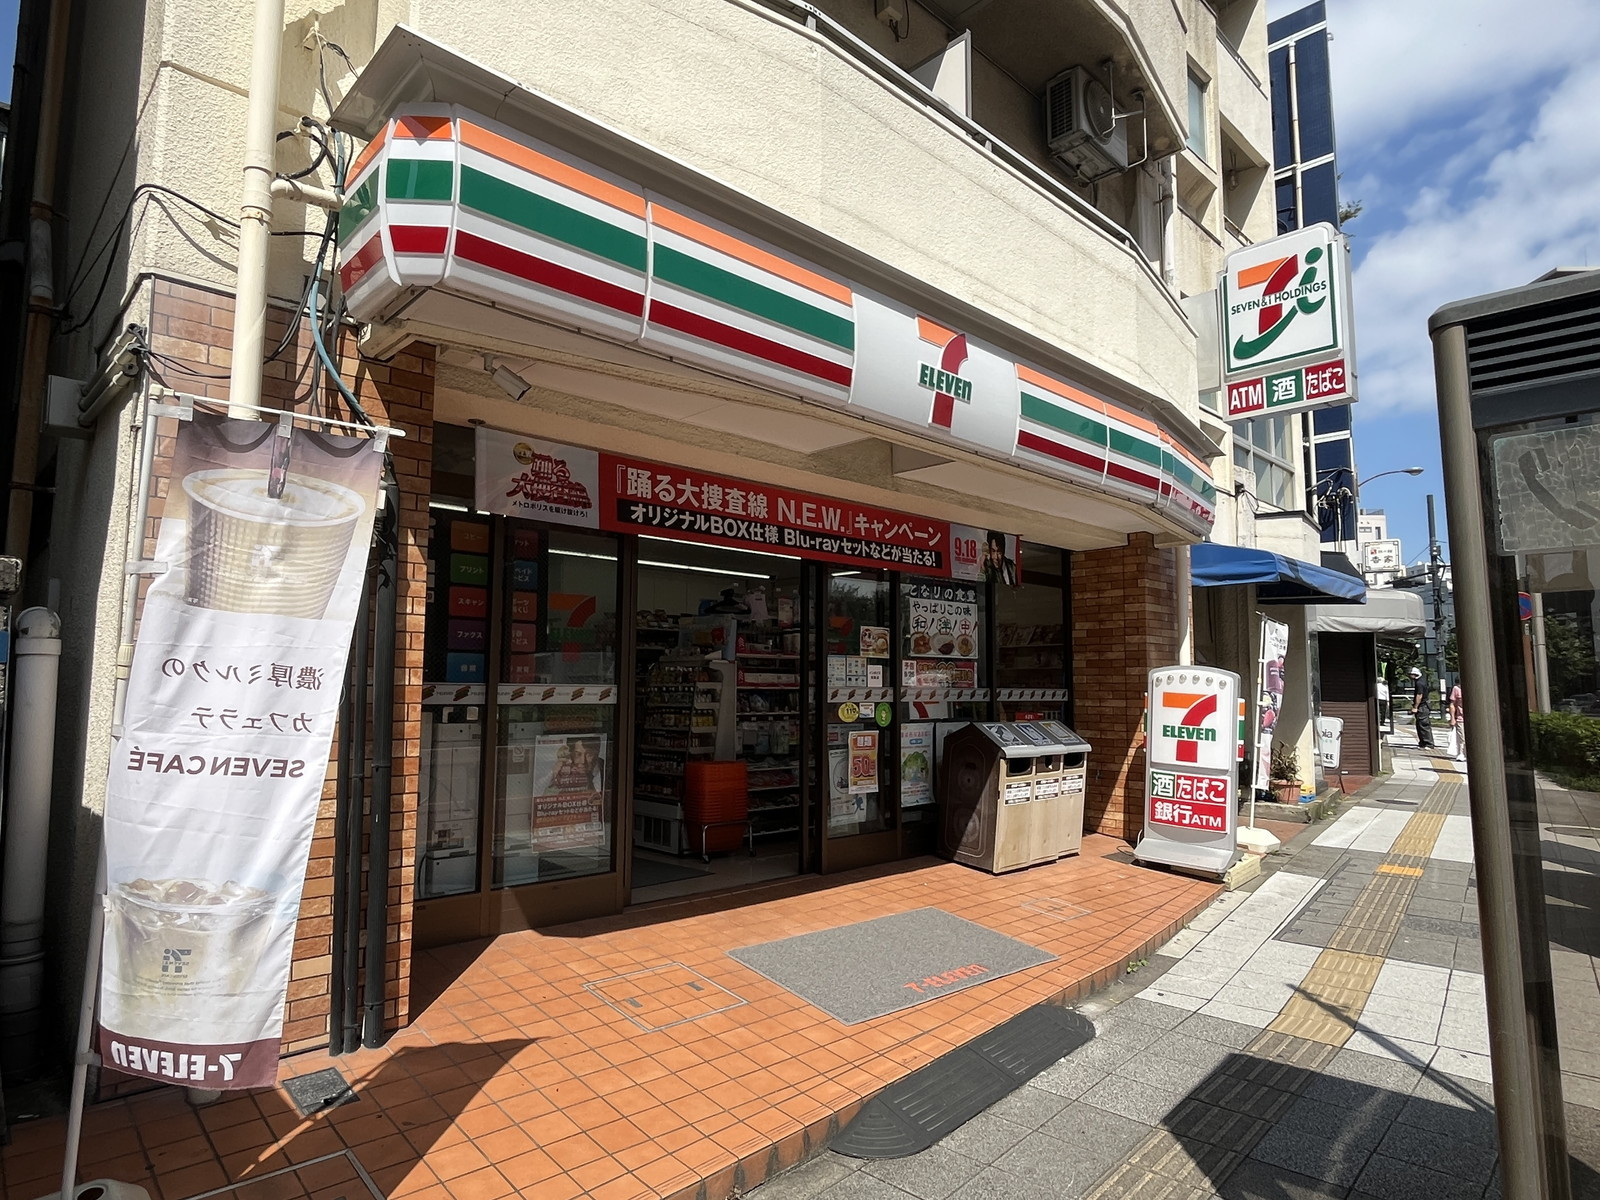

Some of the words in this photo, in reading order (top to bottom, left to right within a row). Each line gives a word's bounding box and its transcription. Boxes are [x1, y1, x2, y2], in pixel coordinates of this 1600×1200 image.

[1274, 280, 1327, 303] HOLDINGS
[920, 363, 972, 402] ELEVEN
[1272, 375, 1296, 402] 酒
[1306, 367, 1344, 395] たばこ
[1230, 383, 1262, 411] ATM
[616, 464, 768, 519] 『踊る大捜査線
[630, 503, 779, 543] オリジナルBOX仕様
[784, 528, 936, 567] Blu-rayセットなどが当たる!
[955, 537, 977, 559] 9.18
[459, 565, 485, 574] プリント
[457, 597, 484, 606] スキャン
[909, 583, 977, 603] となりの食堂
[912, 601, 972, 616] やっぱりこの味
[456, 630, 483, 639] ファクス
[1162, 725, 1217, 742] ELEVEN
[1152, 771, 1174, 797] 酒
[1176, 776, 1226, 802] たばこ
[1153, 801, 1222, 828] 銀行ATM
[903, 963, 990, 994] 7-ELEVEN
